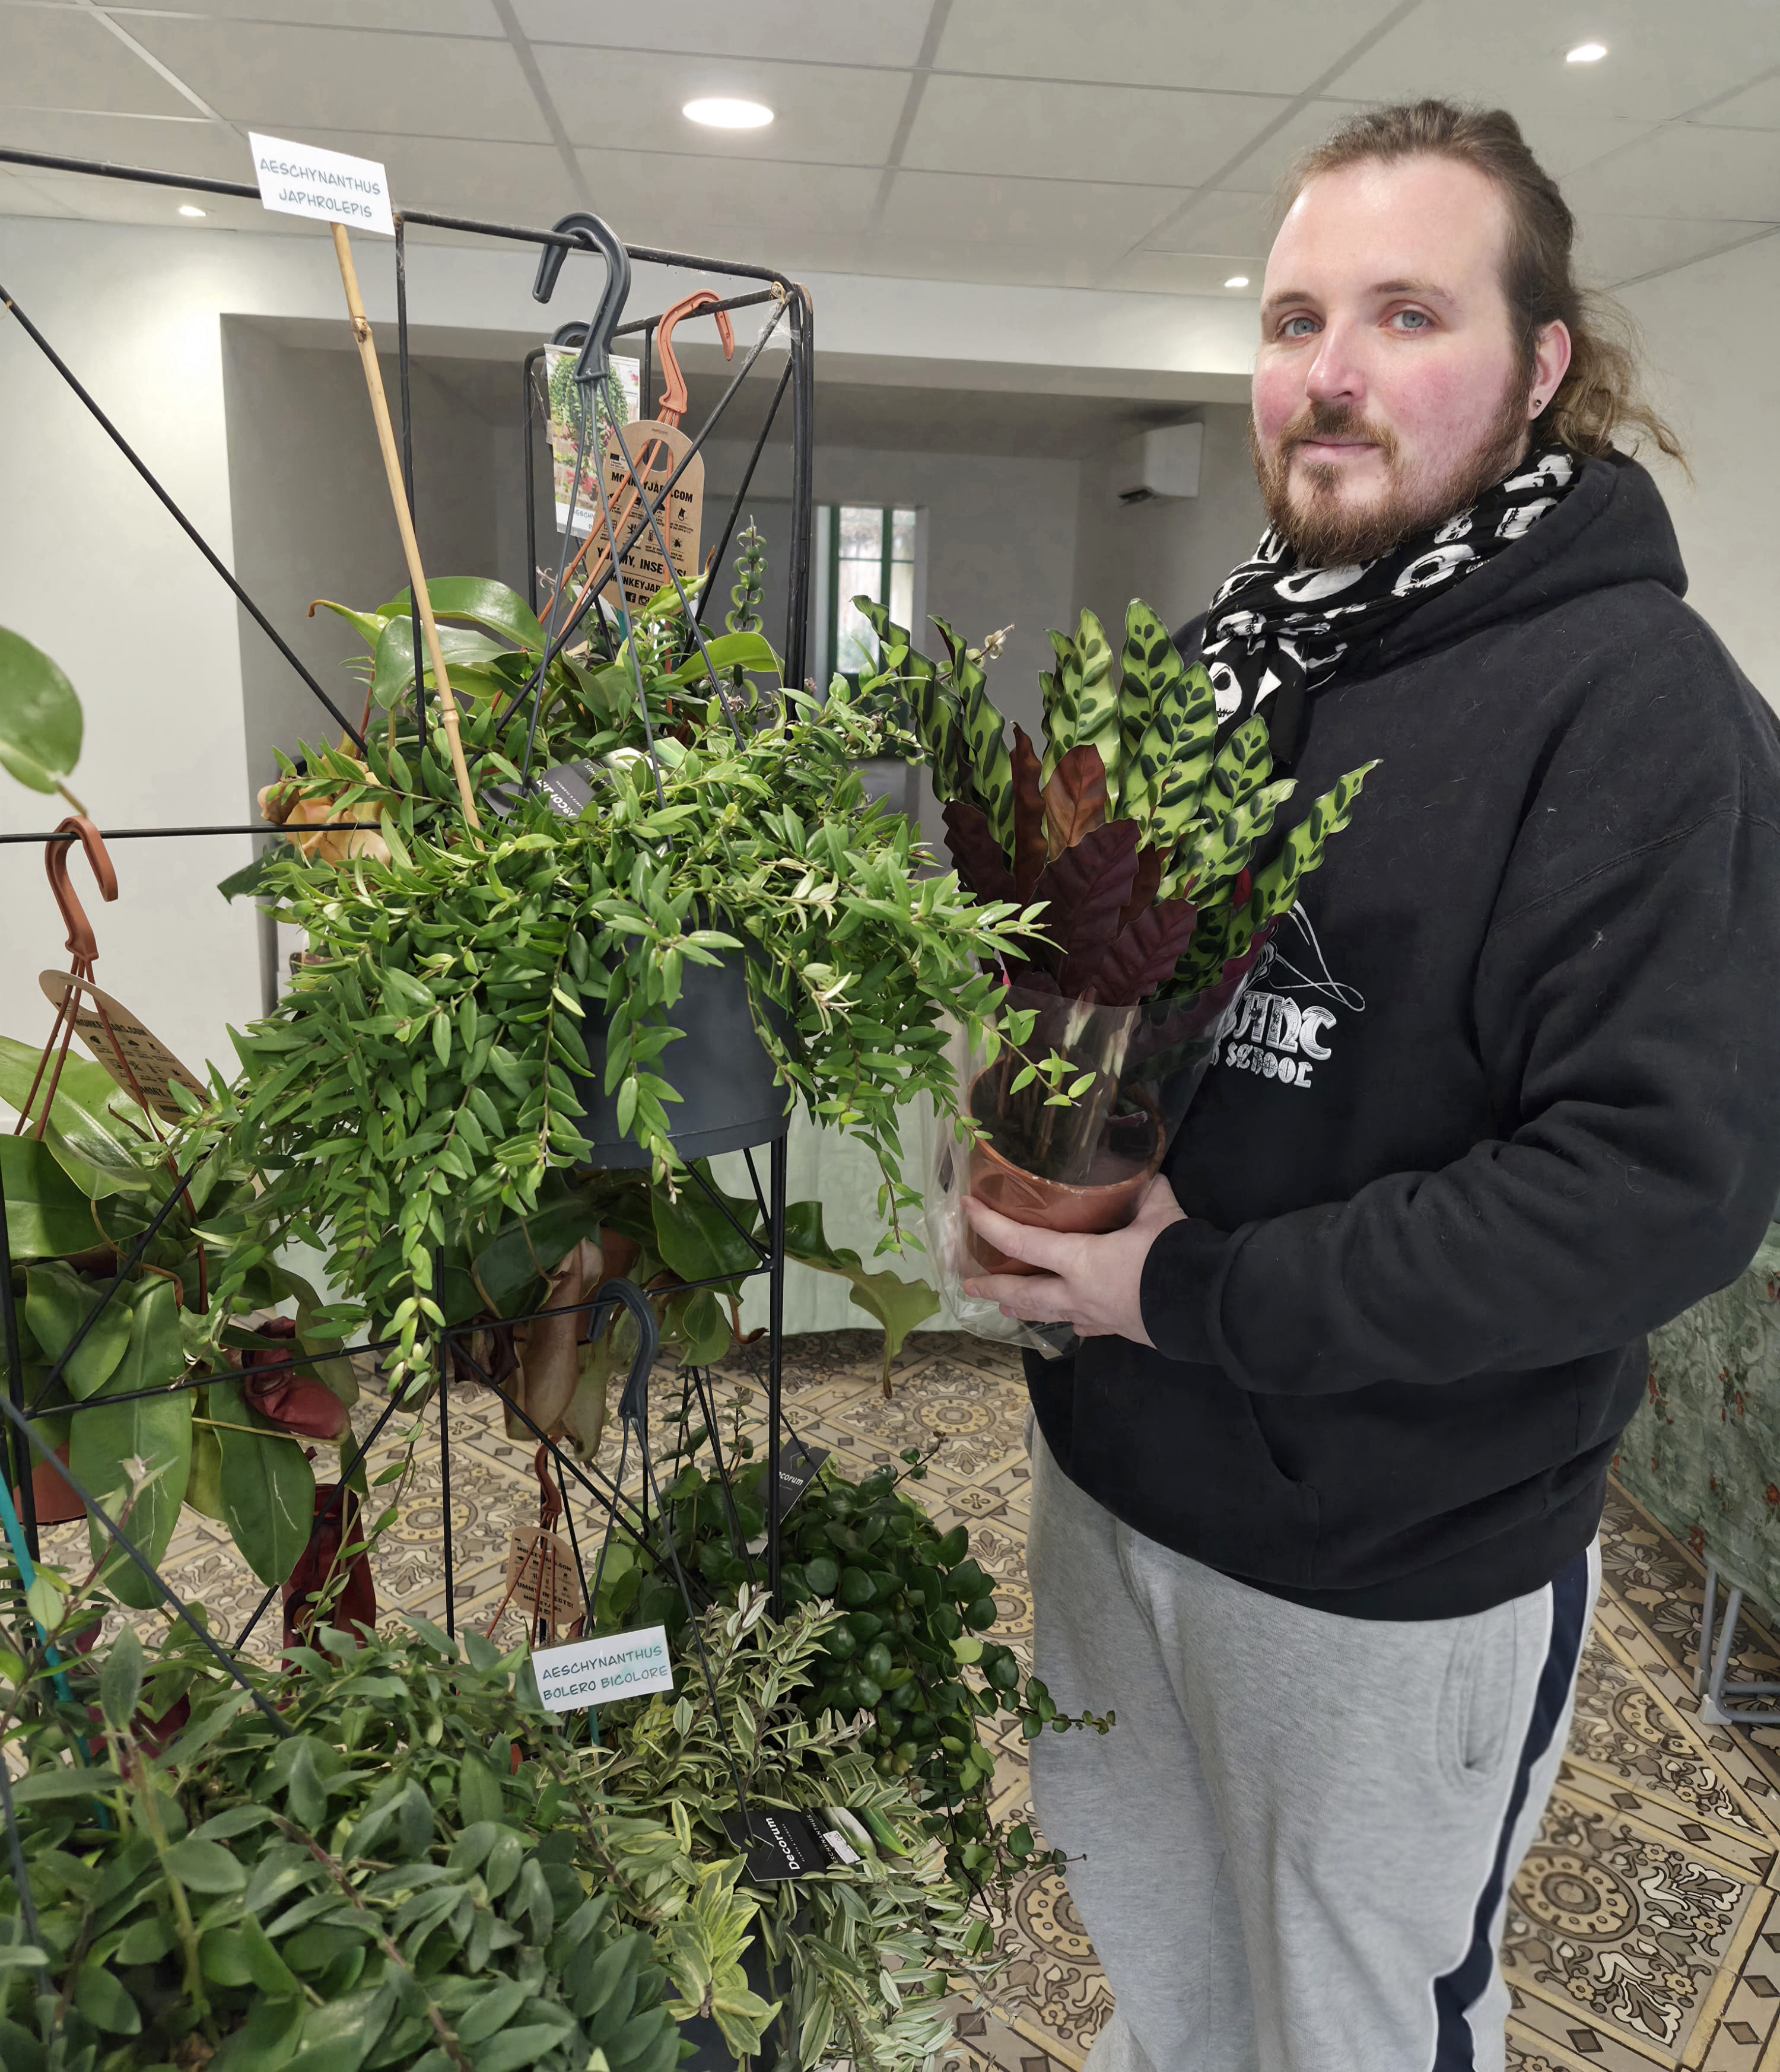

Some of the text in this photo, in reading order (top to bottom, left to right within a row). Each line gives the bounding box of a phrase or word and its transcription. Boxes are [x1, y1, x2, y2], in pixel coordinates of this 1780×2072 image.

[260, 158, 380, 195] AESCHYNANTHUS
[279, 189, 373, 218] JAPHROLEPIS
[611, 472, 693, 503] MOKYJAR.COM
[597, 546, 686, 577] YUMY, INSES!
[542, 1645, 662, 1680] AESCHYNANTHUS
[543, 1666, 669, 1701] BOLERO BICOLORE
[765, 1817, 800, 1870] Decorum
